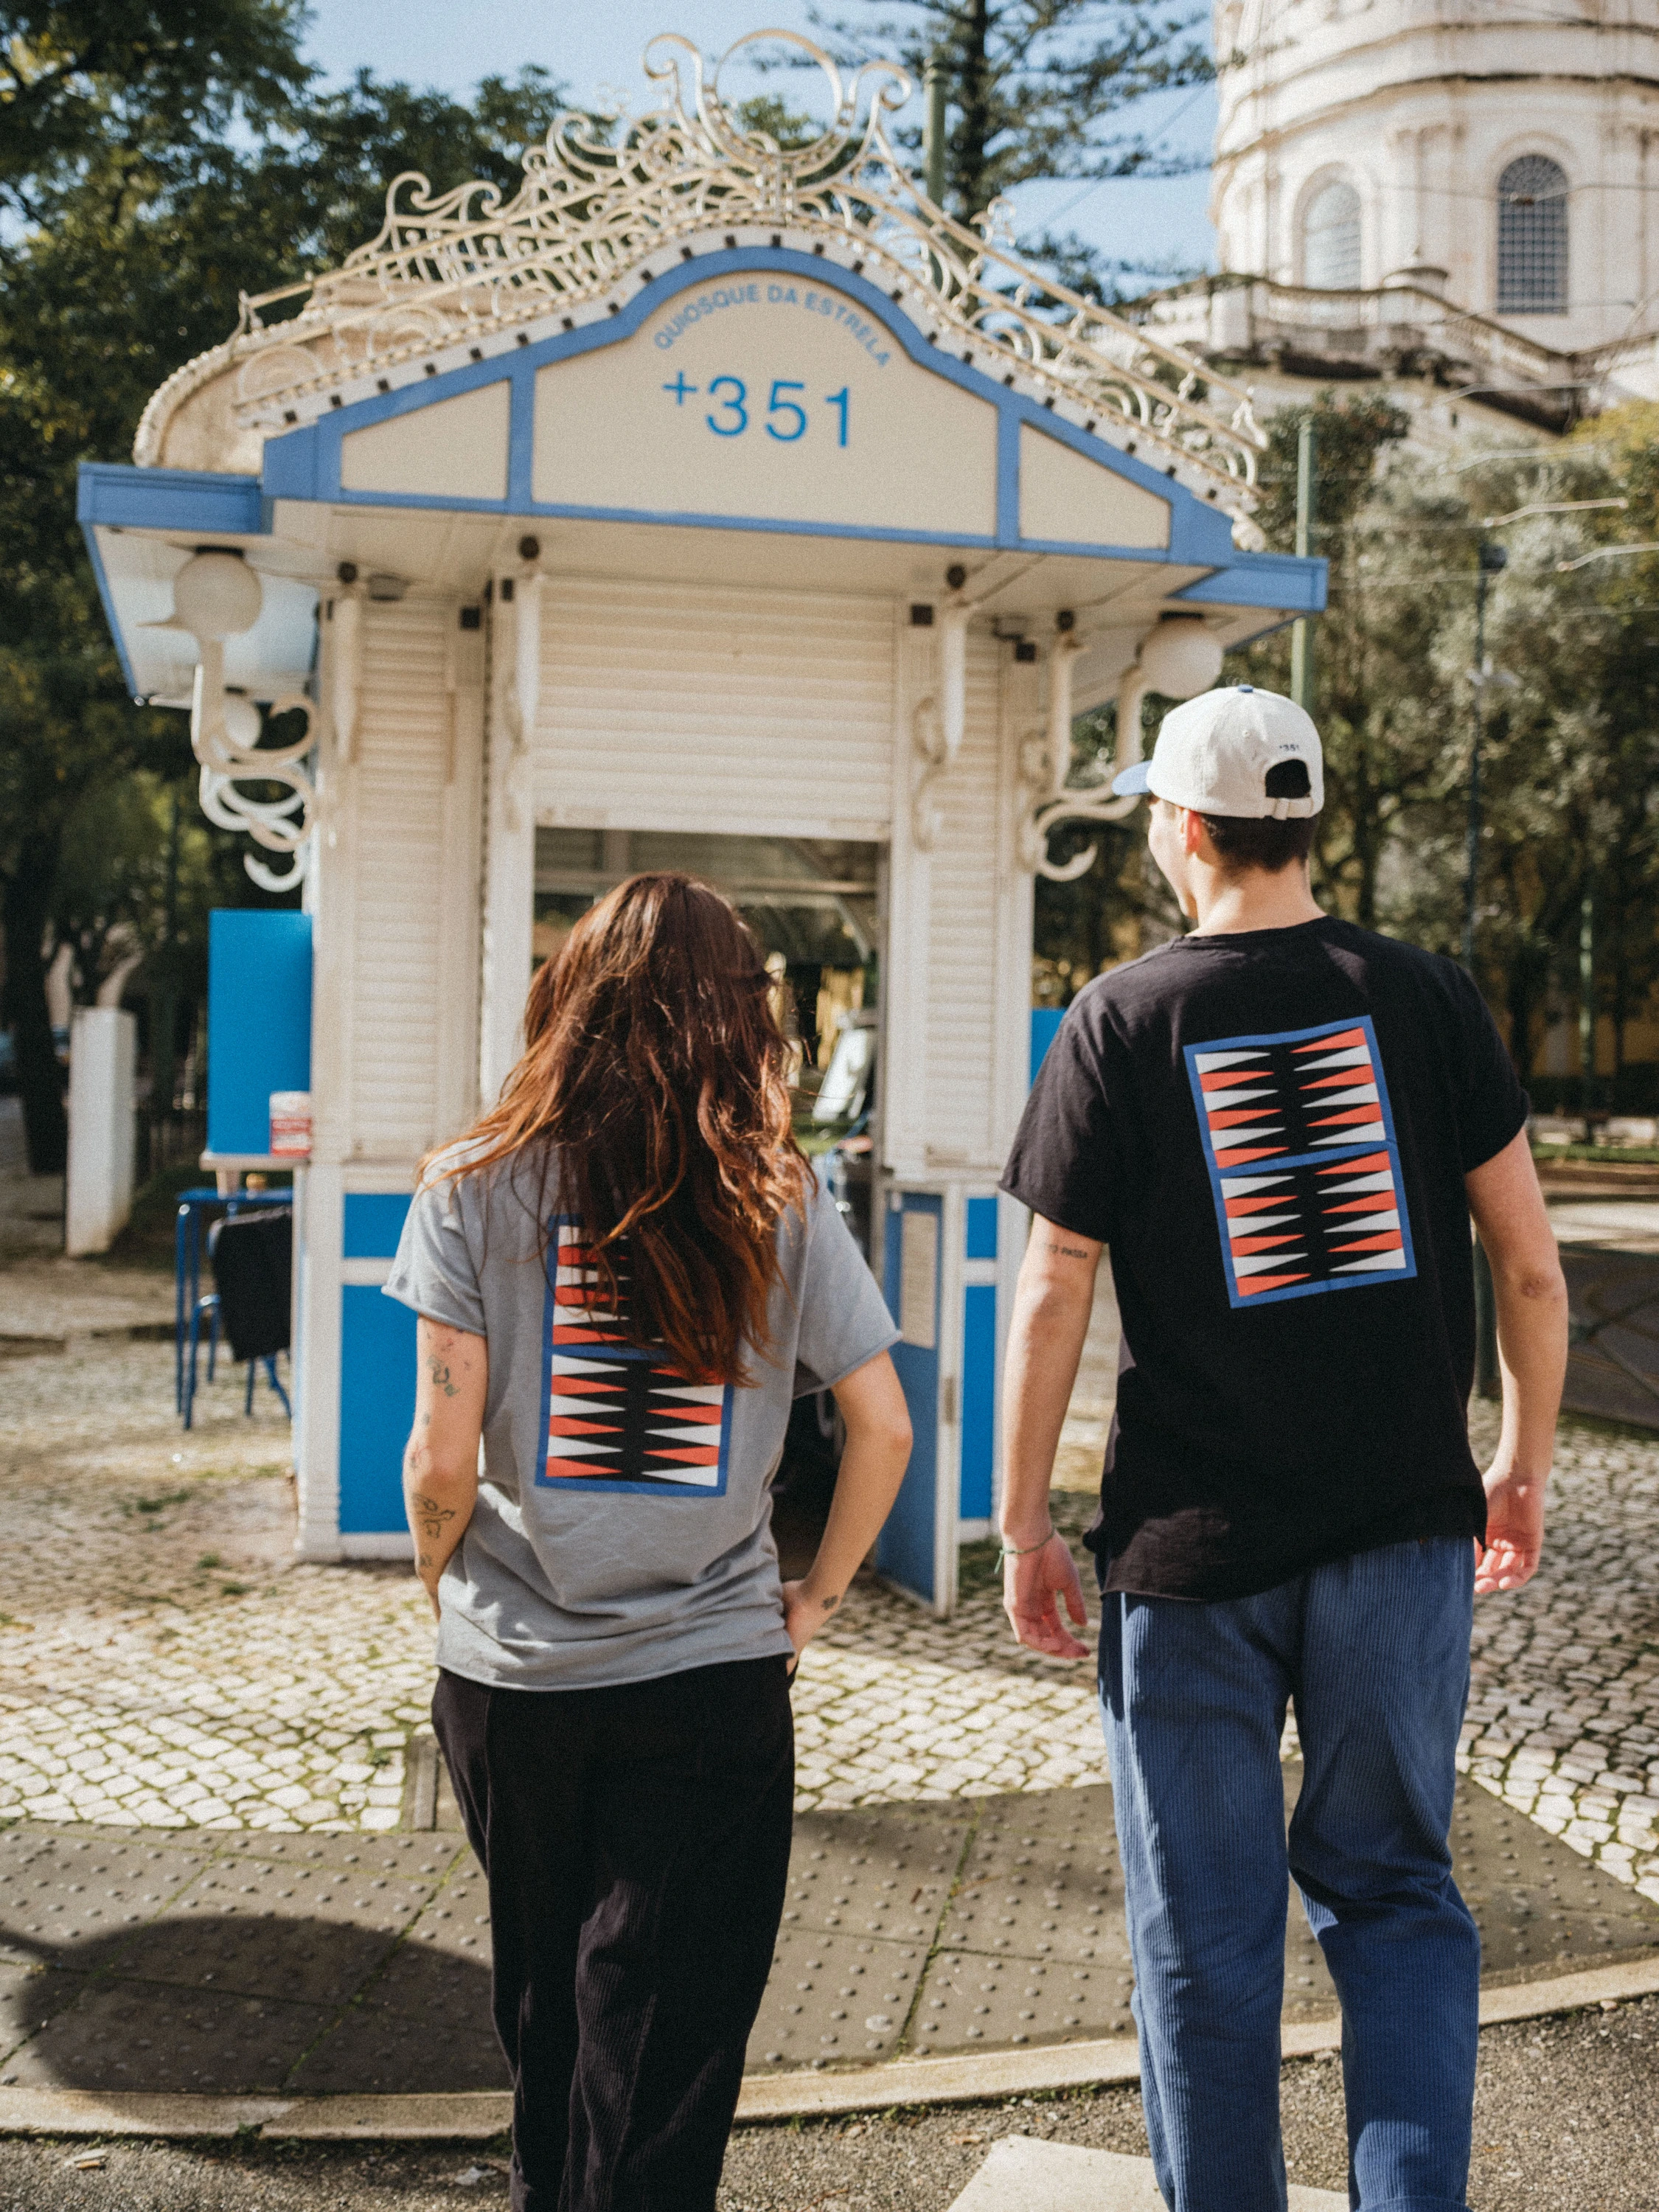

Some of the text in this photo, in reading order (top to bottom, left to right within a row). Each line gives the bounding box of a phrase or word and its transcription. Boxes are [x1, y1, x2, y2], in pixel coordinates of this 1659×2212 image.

[654, 284, 891, 366] QUIOSQUE DA ESTRELA
[663, 371, 850, 447] +351
